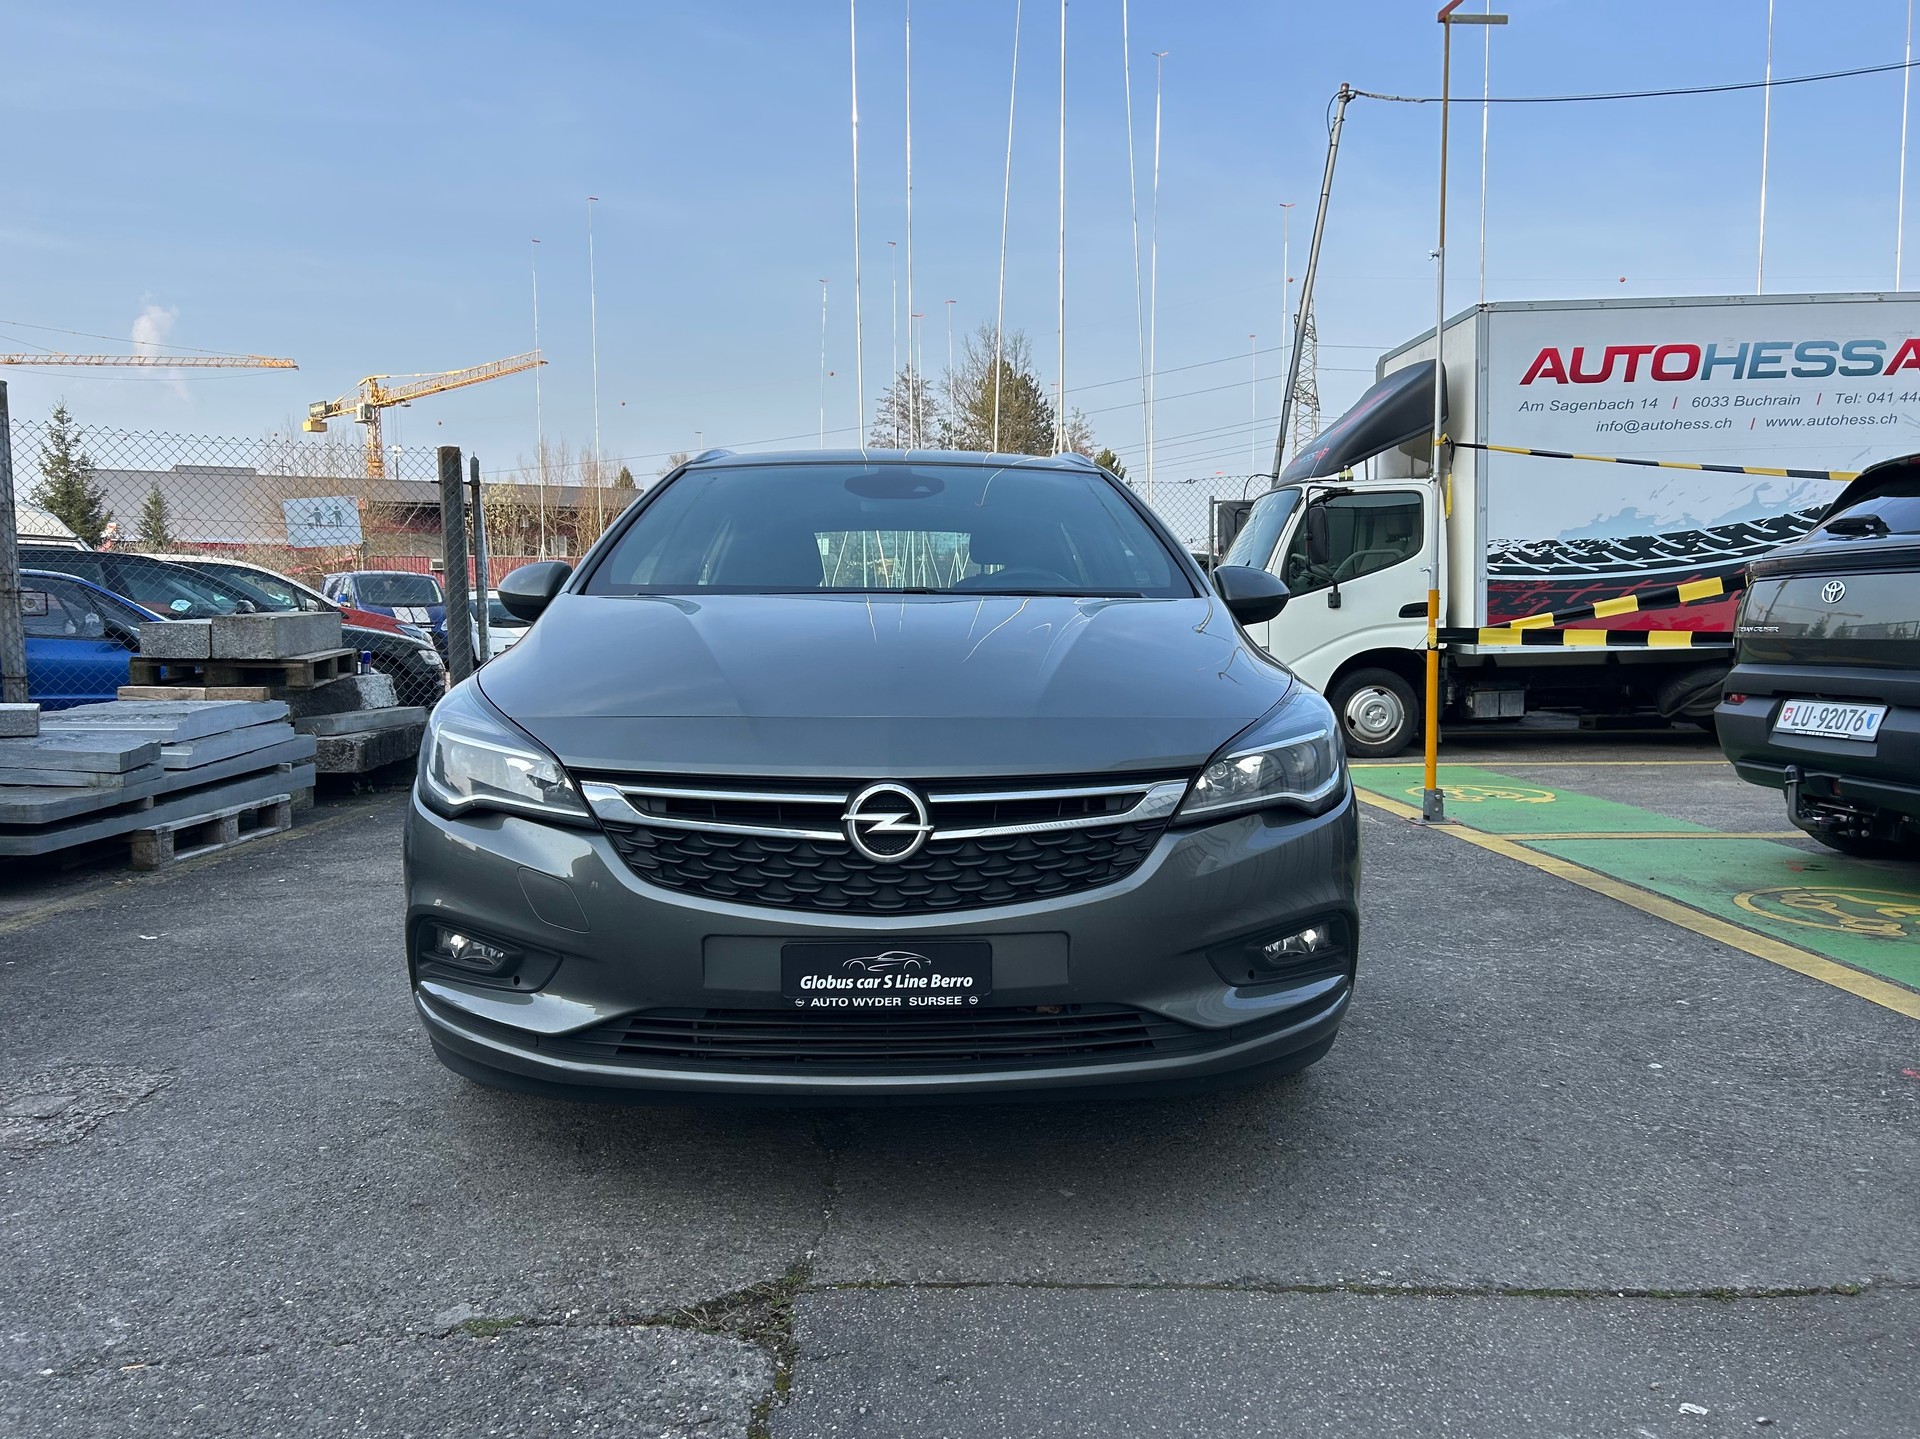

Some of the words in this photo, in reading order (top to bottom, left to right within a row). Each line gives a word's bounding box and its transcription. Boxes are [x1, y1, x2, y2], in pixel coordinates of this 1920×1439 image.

[1518, 400, 1545, 412] Am
[1549, 399, 1635, 414] Sagenbach
[1641, 397, 1658, 410] 14
[1691, 395, 1730, 408] 6033
[1733, 394, 1801, 407] Buchrain
[1835, 392, 1862, 405] Tel:
[1867, 391, 1894, 404] 041
[1899, 391, 1920, 403] 44
[1595, 417, 1733, 434] info@autohess.ch
[1765, 412, 1898, 427] www.autohess.ch
[800, 974, 855, 990] Globus
[856, 976, 880, 989] car
[883, 974, 893, 989] S
[895, 973, 928, 989] Line
[930, 973, 974, 988] Berro
[810, 997, 849, 1007] AUTO
[852, 997, 902, 1007] WYDER
[908, 995, 963, 1006] SURSEE
